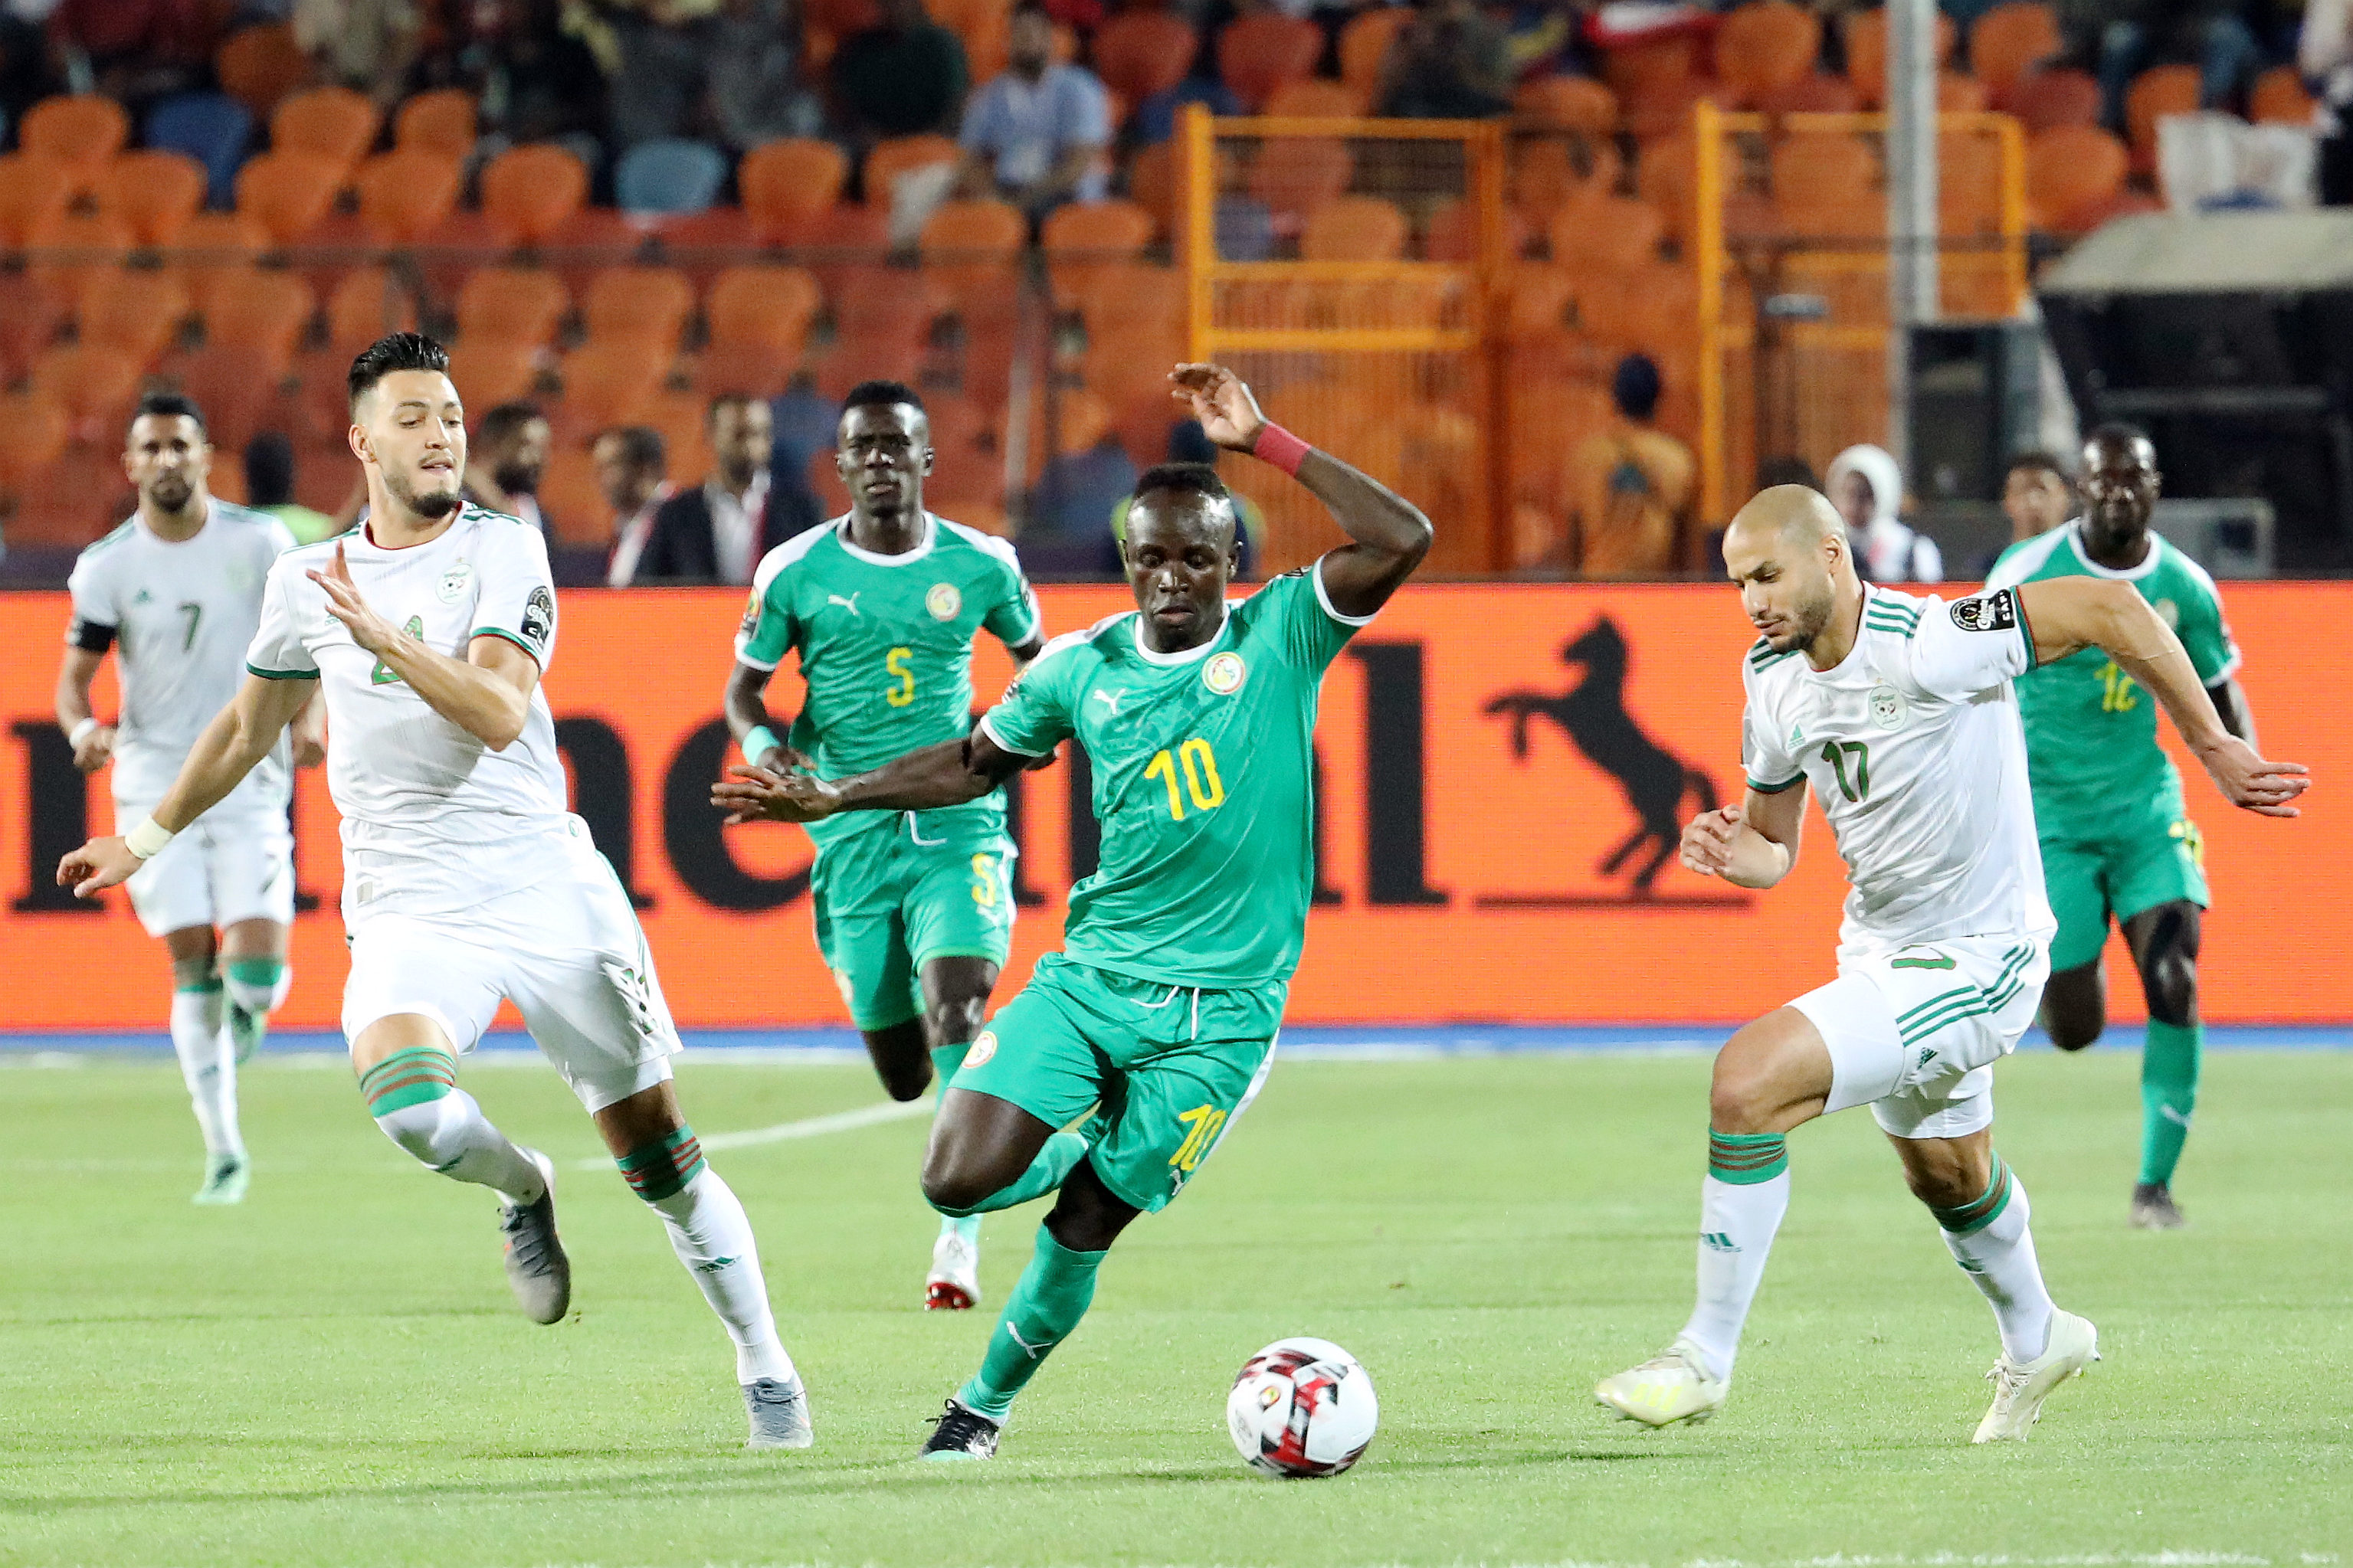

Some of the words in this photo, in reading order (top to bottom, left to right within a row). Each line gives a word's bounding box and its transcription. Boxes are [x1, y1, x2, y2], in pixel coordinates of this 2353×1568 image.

[177, 601, 202, 653] 7
[886, 647, 915, 708] 5
[1143, 737, 1224, 821] 10
[1820, 741, 1870, 802] 17
[1168, 1104, 1226, 1172] 10
